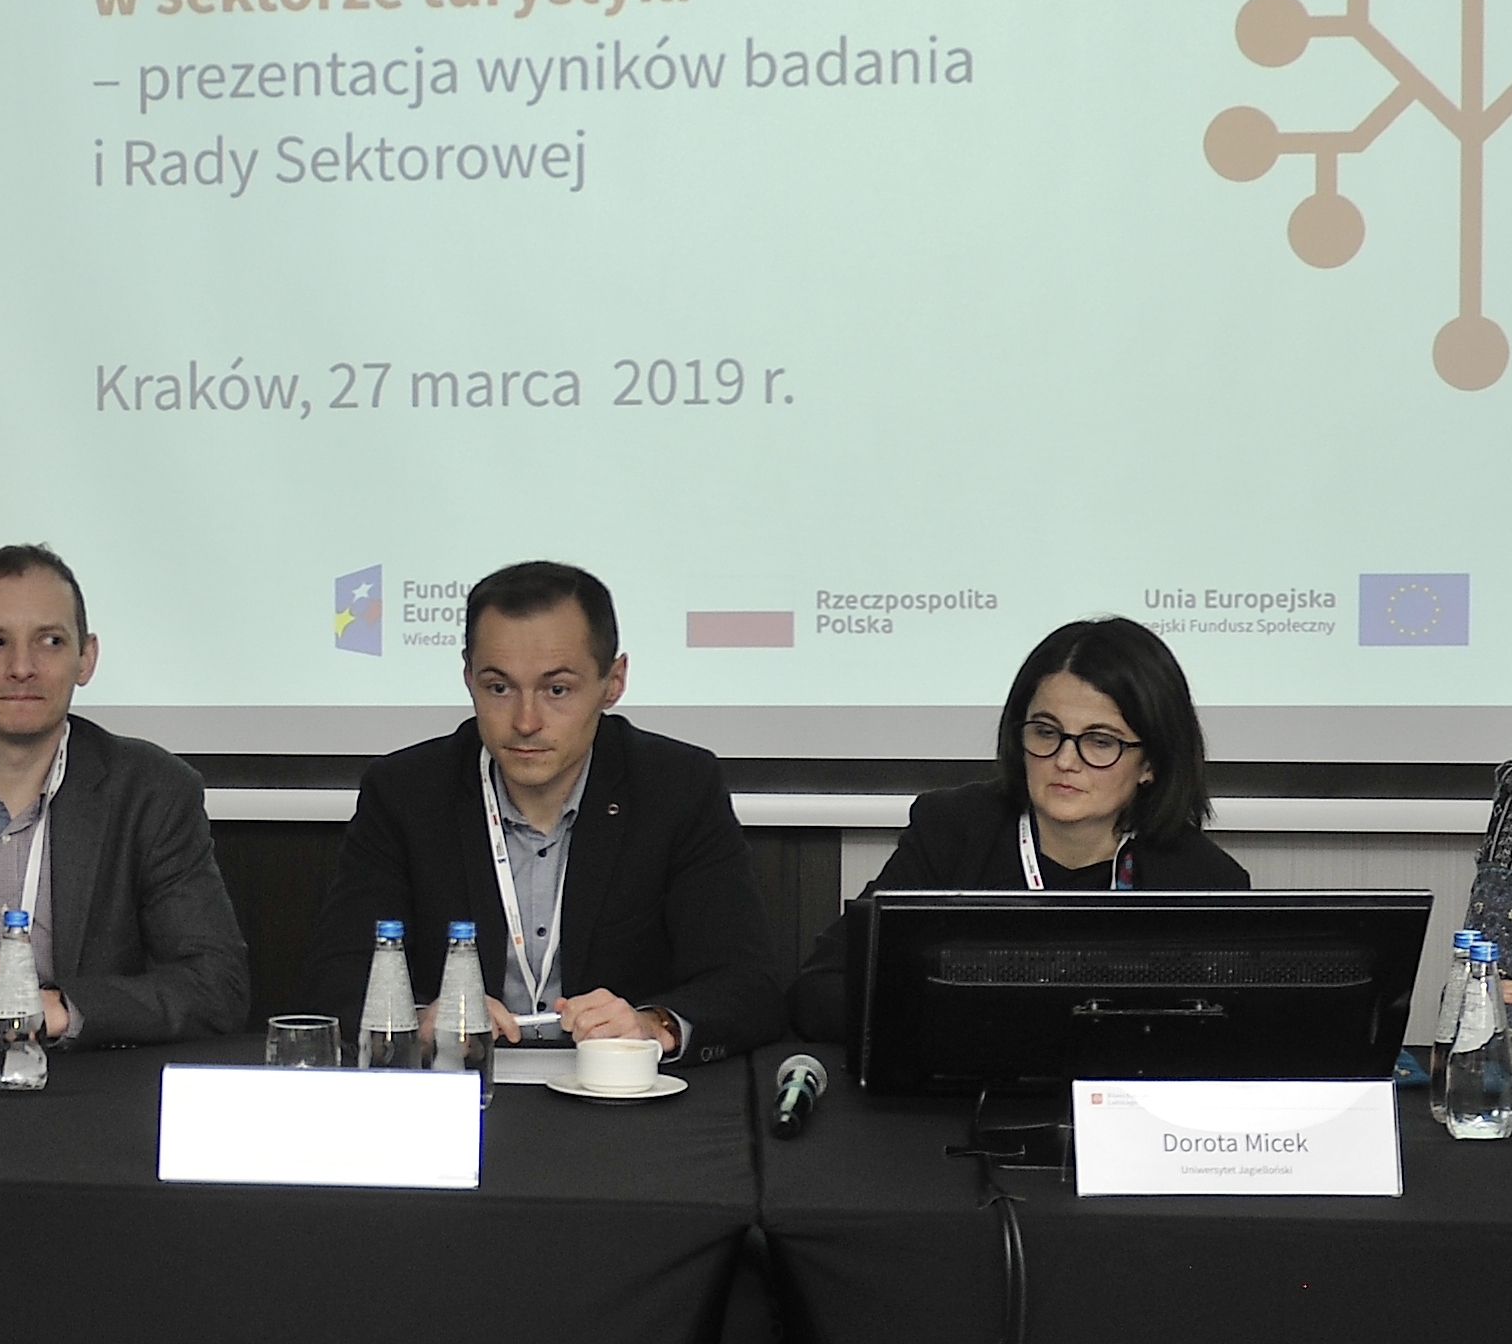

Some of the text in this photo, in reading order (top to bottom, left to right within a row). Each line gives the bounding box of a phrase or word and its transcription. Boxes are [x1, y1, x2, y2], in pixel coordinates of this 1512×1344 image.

[138, 45, 458, 114] prezentacja
[475, 36, 727, 104] wyników
[743, 34, 976, 88] badania
[93, 131, 588, 198] i Rady Sektorowej
[95, 358, 796, 420] Kraków, 27 marca 2019 r.
[402, 581, 472, 600] Fundu
[817, 589, 998, 613] Rzeczpospolita
[1144, 587, 1337, 616] Unia Europejska
[402, 605, 467, 626] Europ
[817, 615, 894, 634] Polska
[1142, 619, 1336, 636] ejski Fundusz Społeczny
[403, 632, 457, 647] Wiedza
[1163, 1133, 1309, 1153] Dorota Micek
[1181, 1163, 1236, 1176] Uniwersytet
